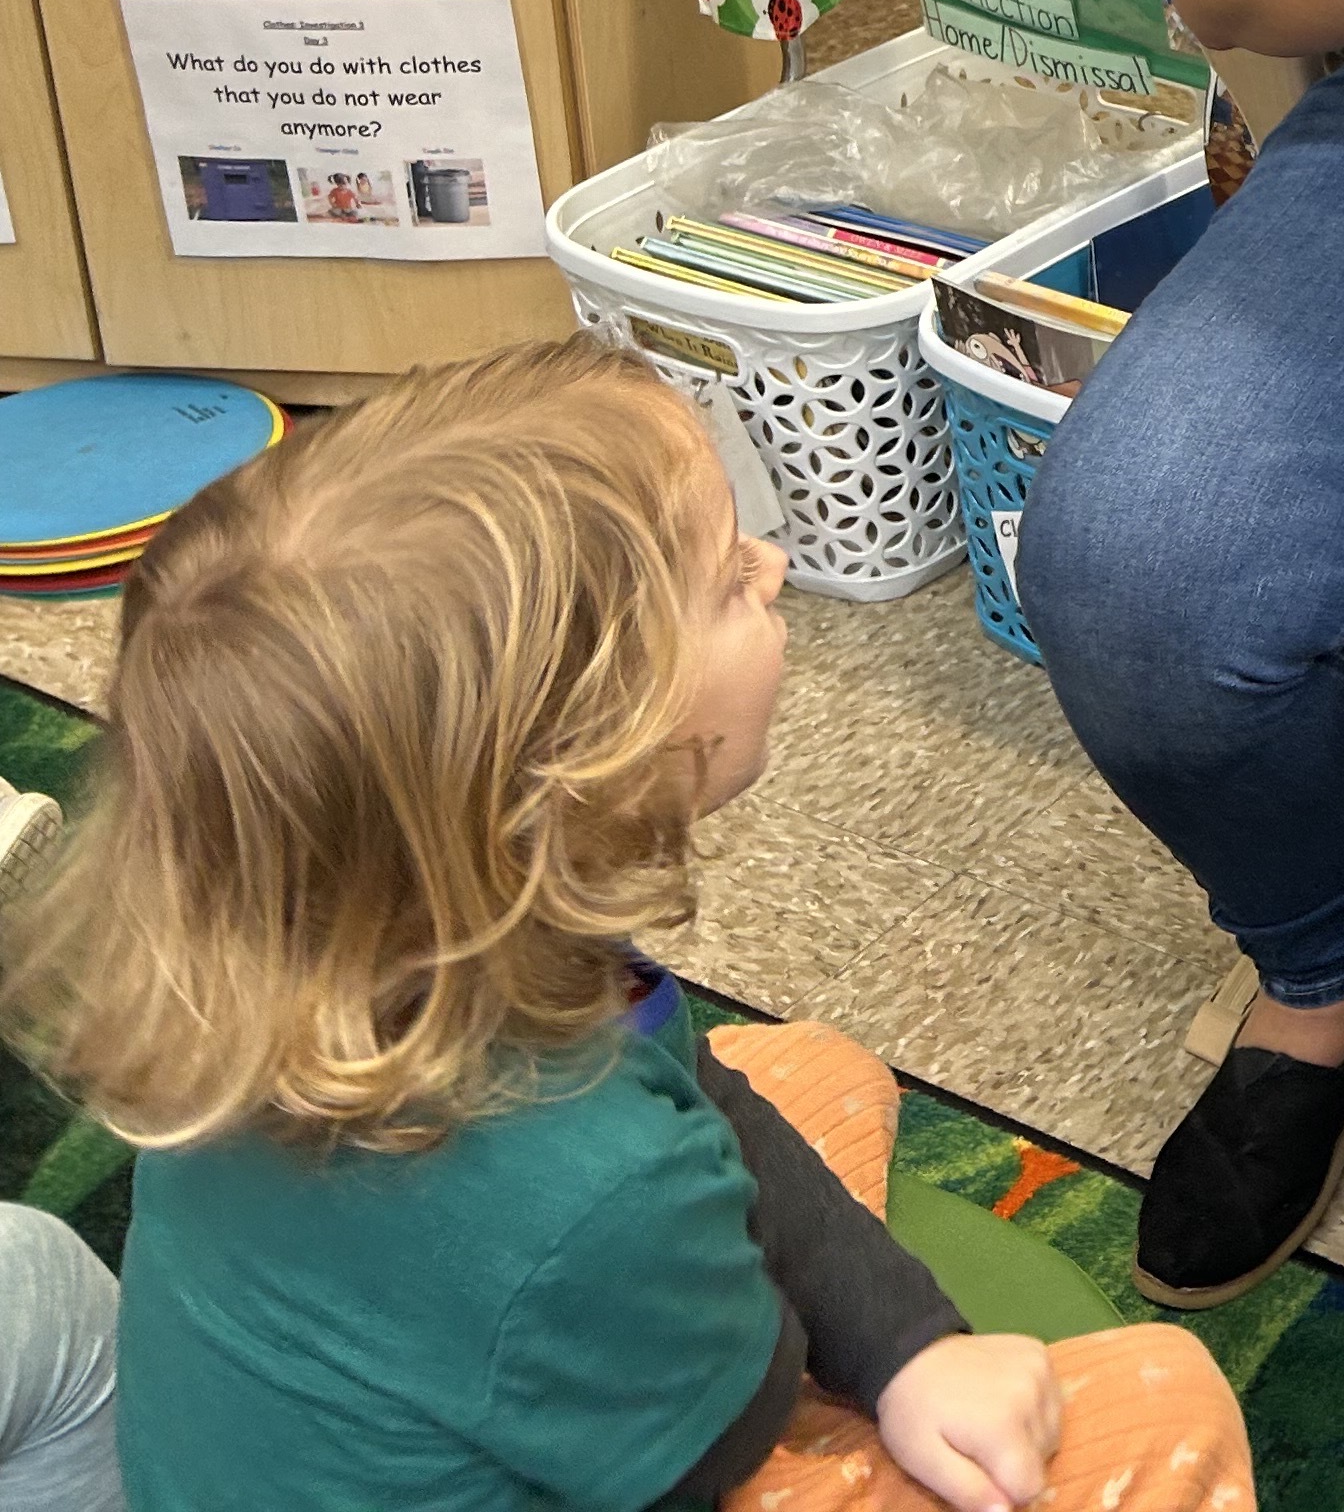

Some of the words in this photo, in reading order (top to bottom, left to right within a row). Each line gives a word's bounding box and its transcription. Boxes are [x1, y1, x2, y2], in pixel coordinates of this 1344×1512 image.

[166, 51, 225, 72] What
[233, 54, 258, 73] do
[265, 60, 303, 79] you
[310, 56, 335, 75] do
[343, 56, 391, 75] with
[400, 55, 481, 75] clothes
[213, 85, 259, 105] that
[267, 90, 304, 109] you
[313, 89, 337, 106] do
[345, 89, 379, 106] not
[387, 89, 442, 106] wear
[280, 120, 382, 140] anymore?
